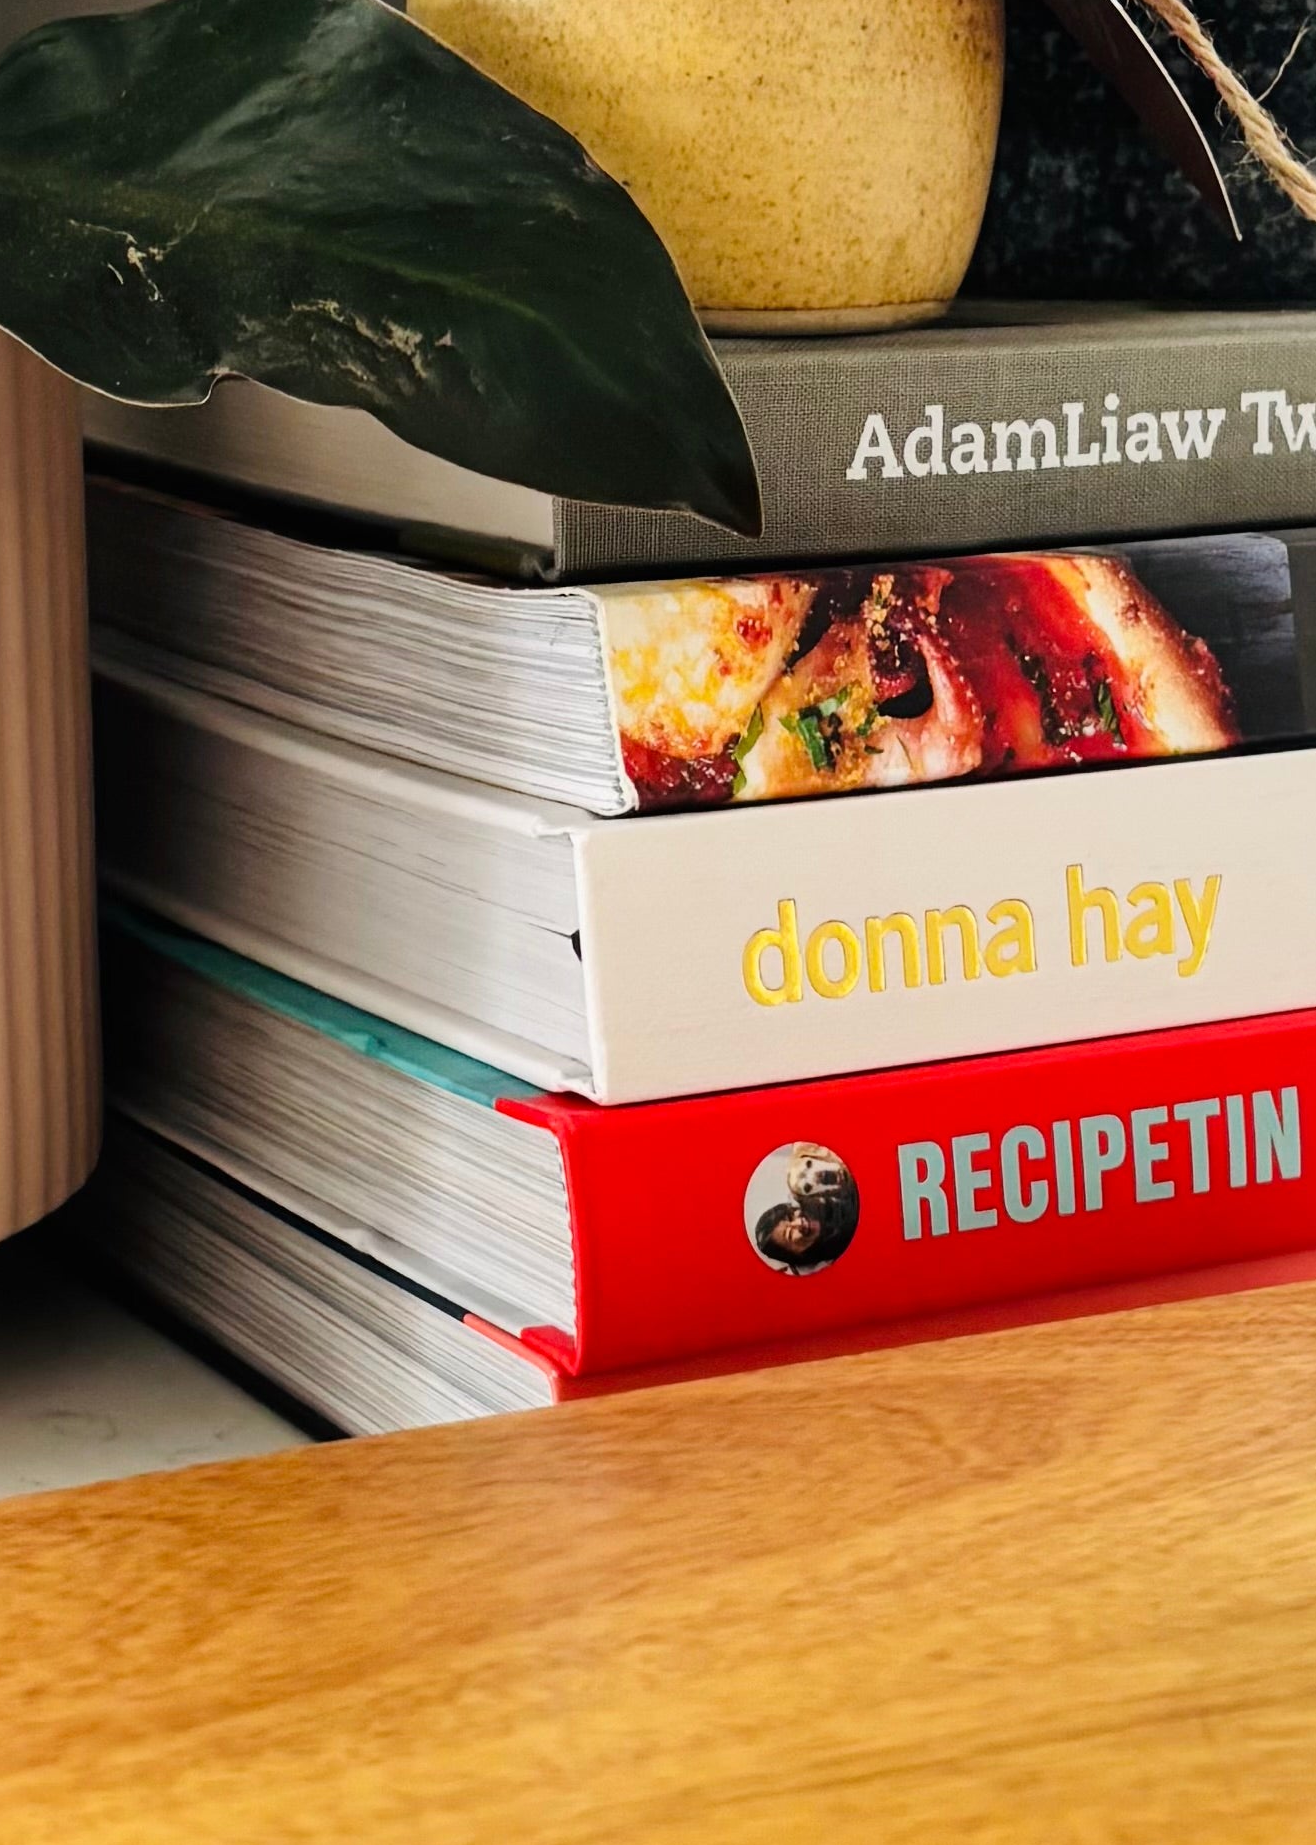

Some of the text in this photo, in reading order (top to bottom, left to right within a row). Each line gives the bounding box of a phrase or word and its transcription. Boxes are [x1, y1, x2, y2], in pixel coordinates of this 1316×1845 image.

[846, 393, 1226, 481] AdamLiaw
[743, 863, 1222, 1007] donna hay
[897, 1085, 1301, 1242] RECIPETIN
